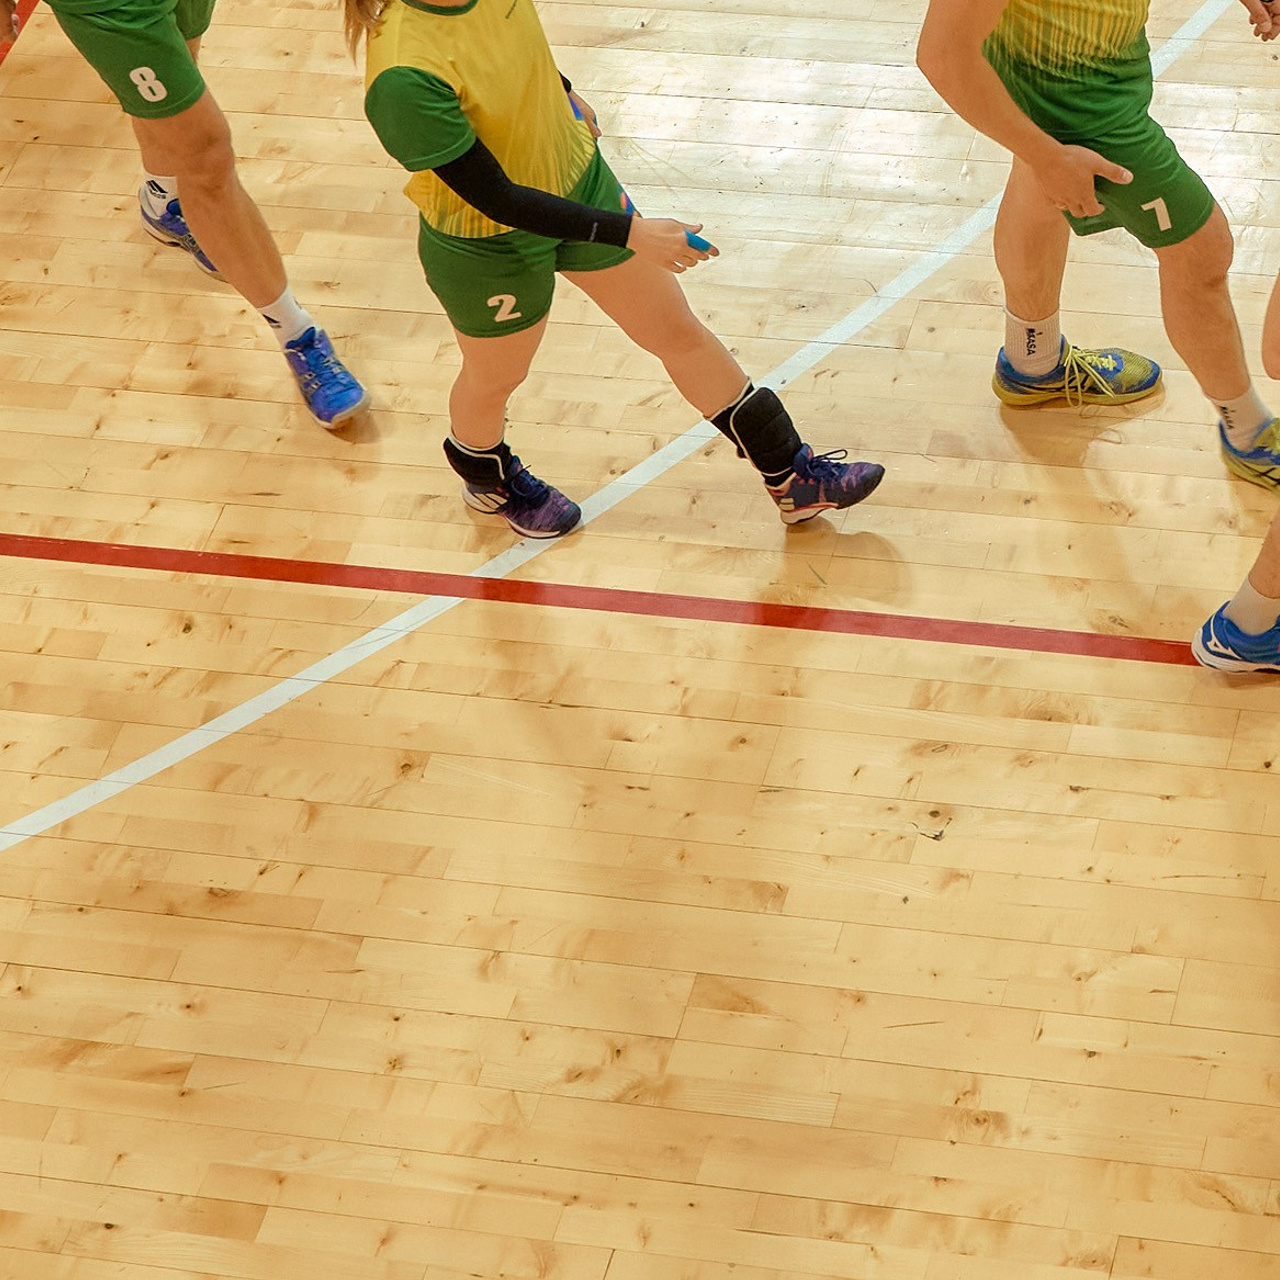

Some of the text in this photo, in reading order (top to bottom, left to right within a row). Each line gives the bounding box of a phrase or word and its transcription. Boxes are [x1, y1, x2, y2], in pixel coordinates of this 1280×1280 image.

[129, 66, 168, 103] 8
[1140, 196, 1172, 232] 7
[486, 294, 522, 322] 2
